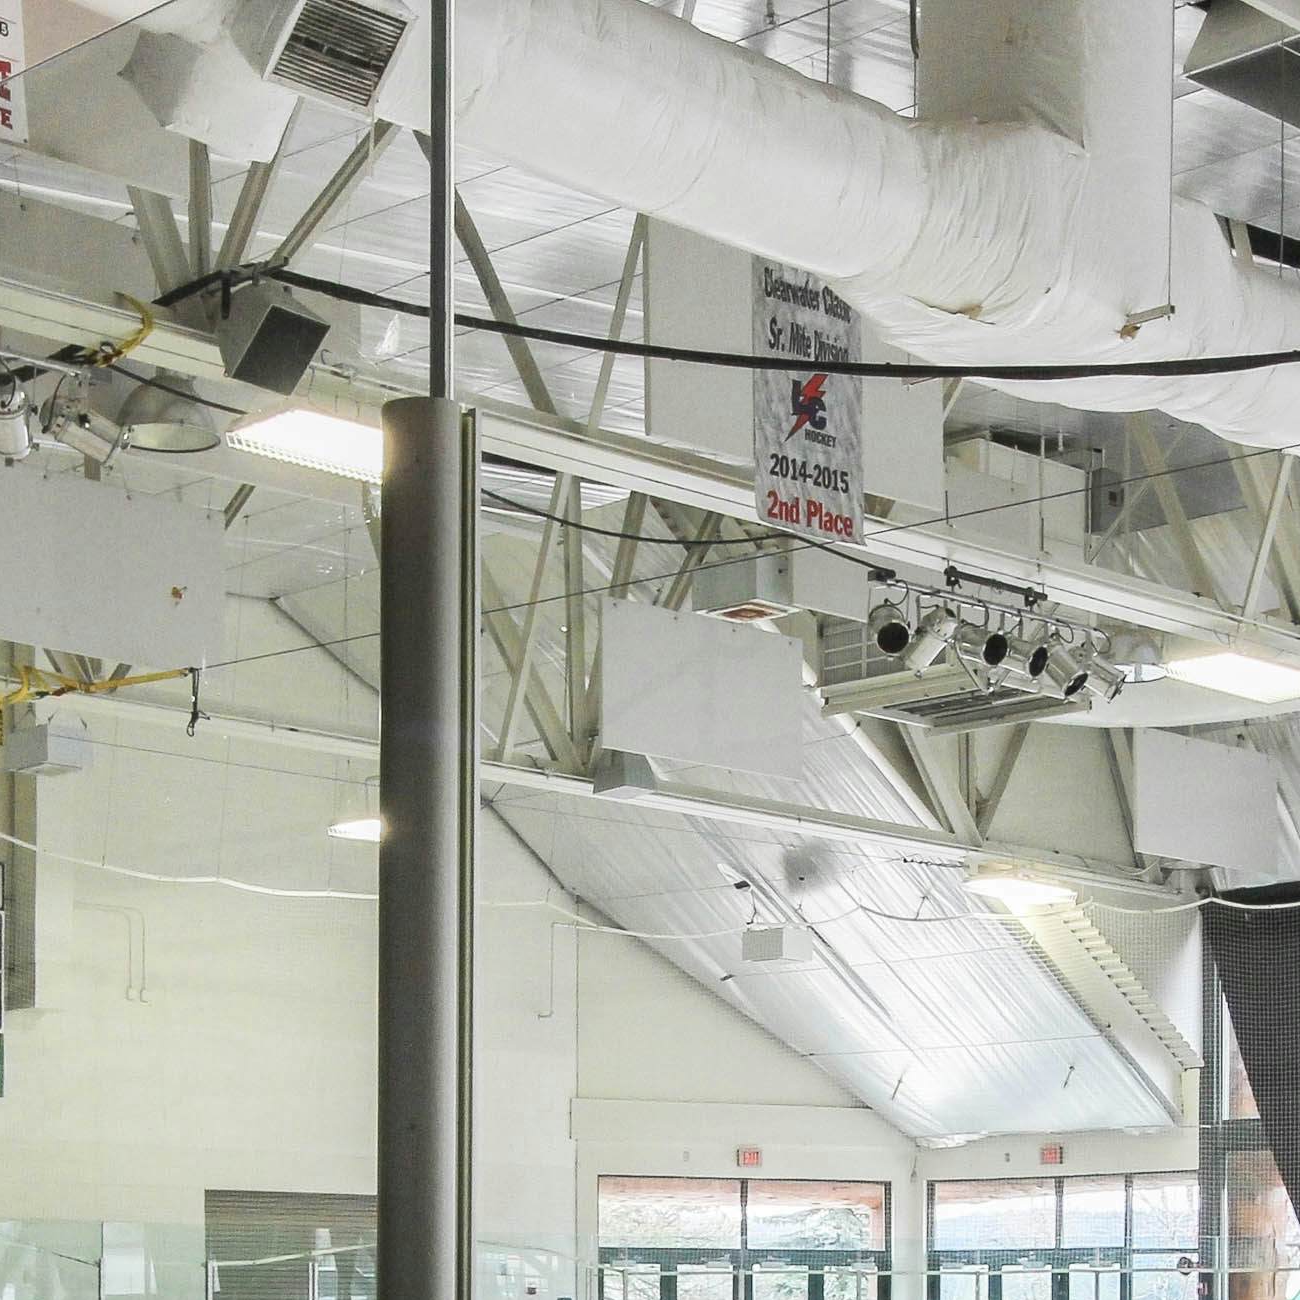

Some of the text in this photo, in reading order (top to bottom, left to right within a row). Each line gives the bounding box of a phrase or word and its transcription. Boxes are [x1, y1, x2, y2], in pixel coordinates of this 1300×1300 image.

[764, 267, 820, 311] Clearwater
[789, 322, 812, 358] Mite
[805, 427, 837, 448] HOCKEY
[769, 453, 849, 493] 2014-2015
[767, 489, 853, 538] 2nd Place
